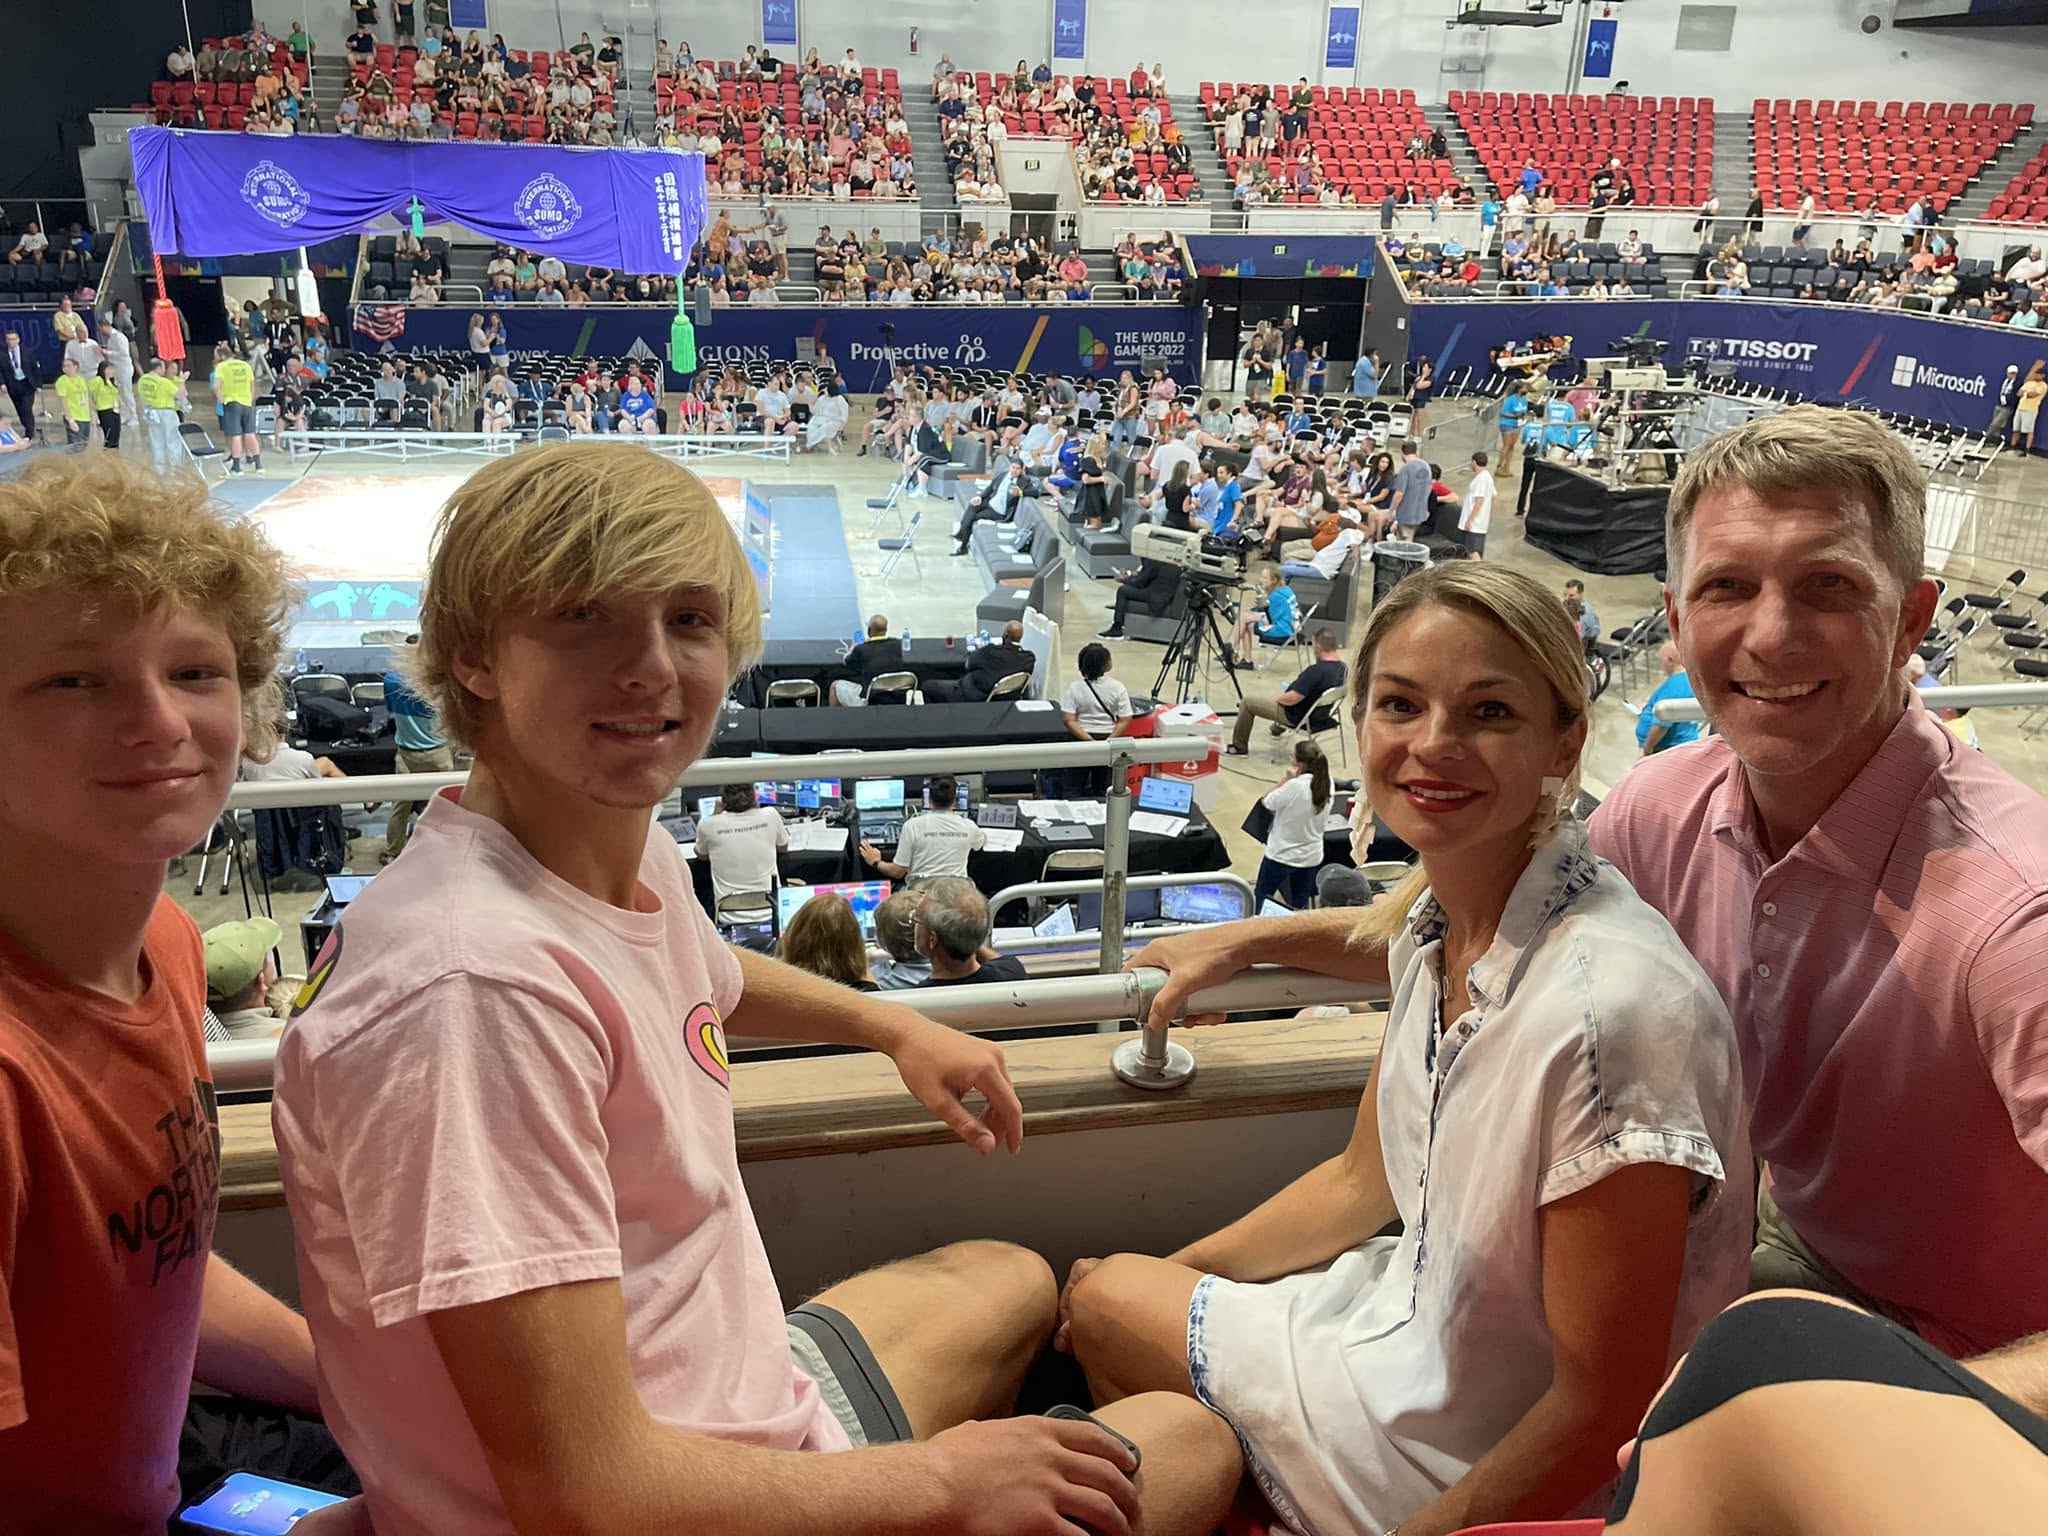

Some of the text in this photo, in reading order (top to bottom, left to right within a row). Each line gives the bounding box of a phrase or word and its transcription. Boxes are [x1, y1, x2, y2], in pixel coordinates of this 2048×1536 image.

[534, 208, 562, 221] SUMO
[1114, 331, 1186, 343] THE WORLD
[850, 342, 949, 361] Protective
[1114, 345, 1185, 356] GAMES 2022
[1723, 338, 1818, 361] TISSOT
[1916, 364, 1986, 398] Microsoft
